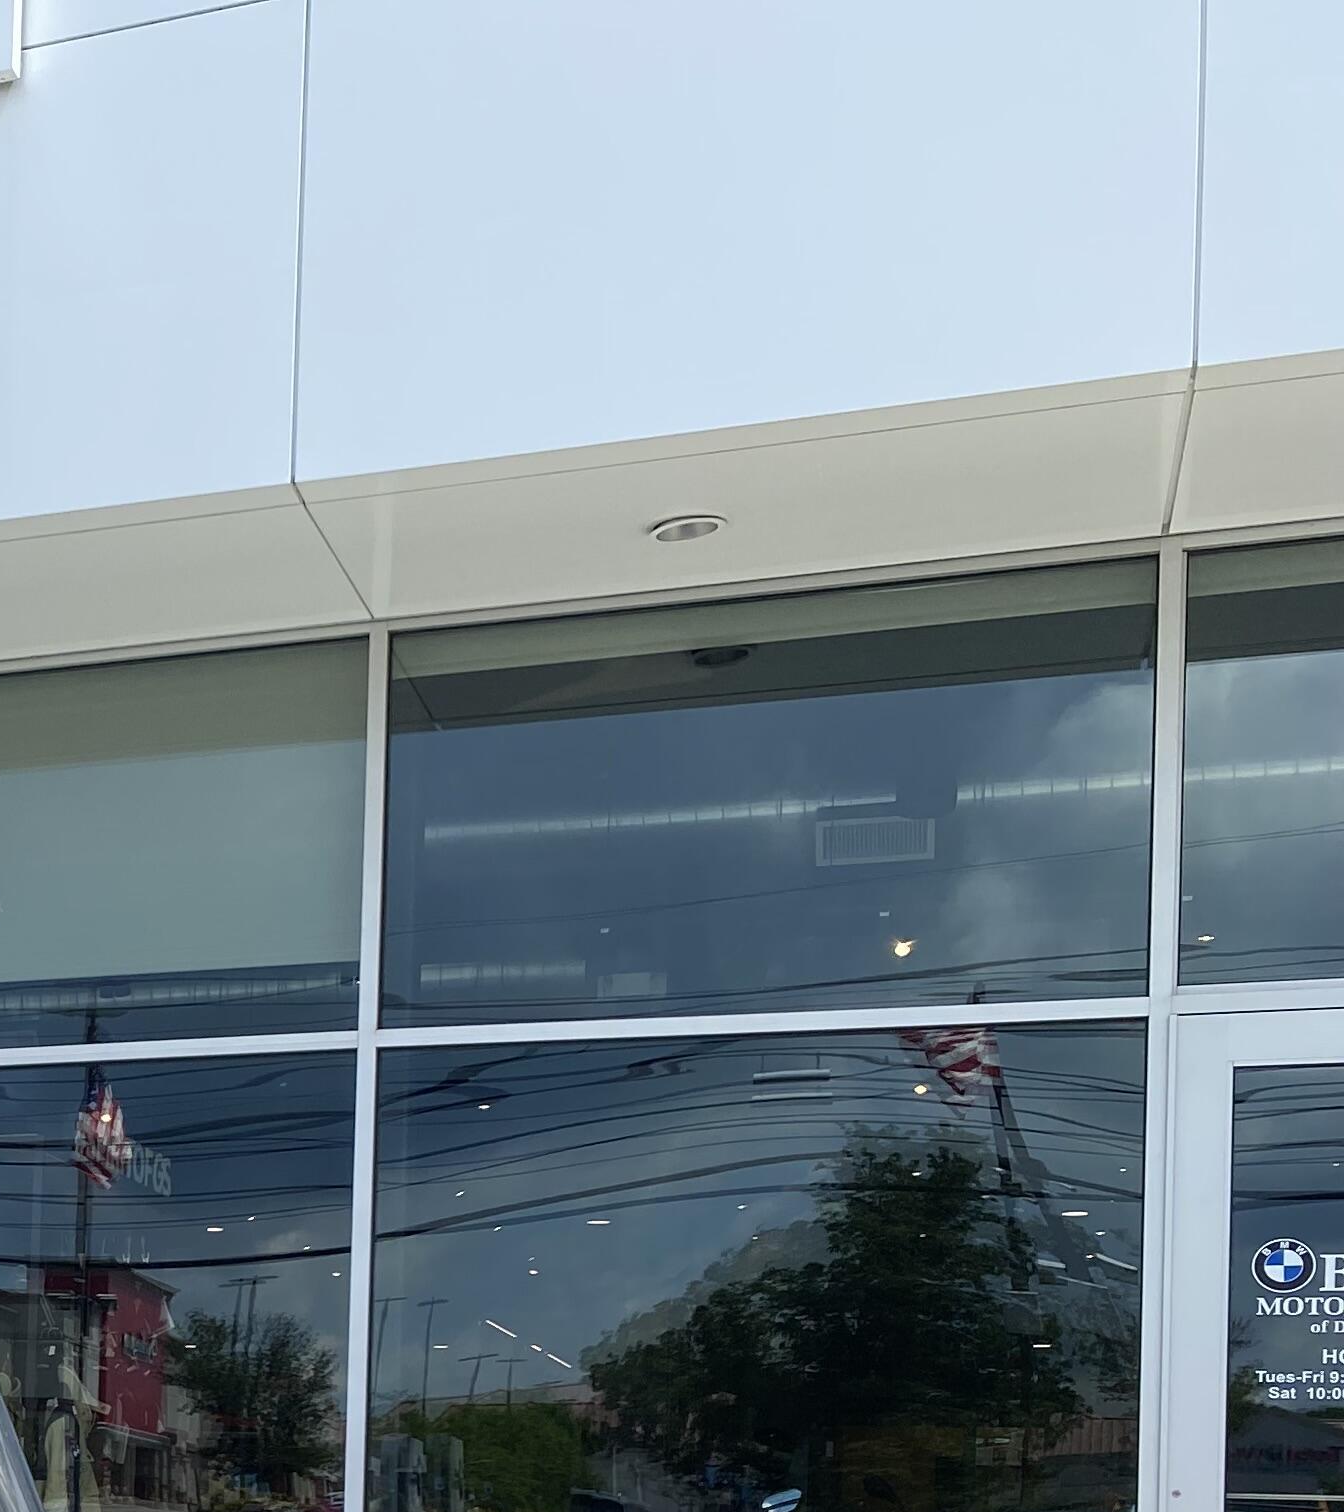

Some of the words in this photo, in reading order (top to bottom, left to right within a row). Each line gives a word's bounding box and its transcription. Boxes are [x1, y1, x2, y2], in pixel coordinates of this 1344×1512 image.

[1262, 1240, 1307, 1257] BMW
[1255, 1296, 1344, 1316] MOTO
[1310, 1320, 1330, 1333] of
[1255, 1370, 1325, 1384] Tues-Fri
[1268, 1387, 1297, 1400] Sat
